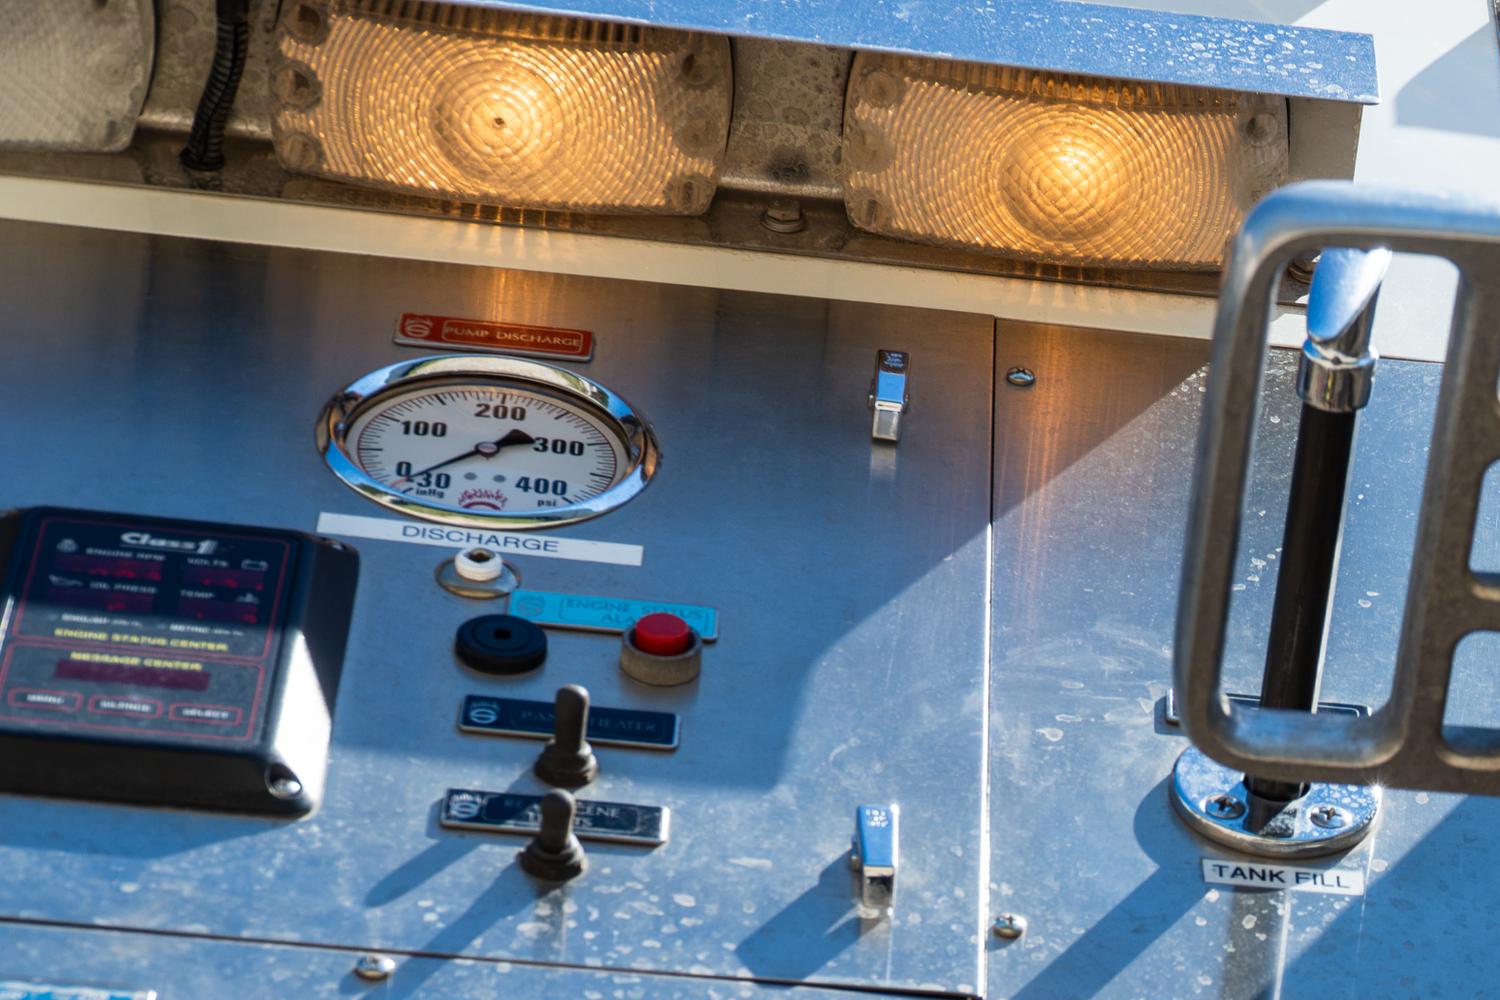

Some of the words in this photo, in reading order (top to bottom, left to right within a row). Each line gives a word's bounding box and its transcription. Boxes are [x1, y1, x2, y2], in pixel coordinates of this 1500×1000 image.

[445, 327, 489, 340] PUMP
[496, 330, 581, 347] DISCHARGE
[474, 402, 527, 421] 200
[401, 420, 447, 438] 100
[533, 437, 585, 457] 300
[515, 476, 567, 496] 400
[401, 525, 560, 553] DISCHARGE
[566, 600, 630, 612] ENGINE
[603, 613, 636, 625] ALA
[54, 628, 108, 641] ENGINE
[112, 633, 168, 647] STATUS
[170, 638, 229, 651] CENTER
[70, 651, 141, 666] MESSAGE
[144, 657, 203, 671] CENTER
[1212, 864, 1286, 883] TANK
[1296, 872, 1351, 889] FILL
